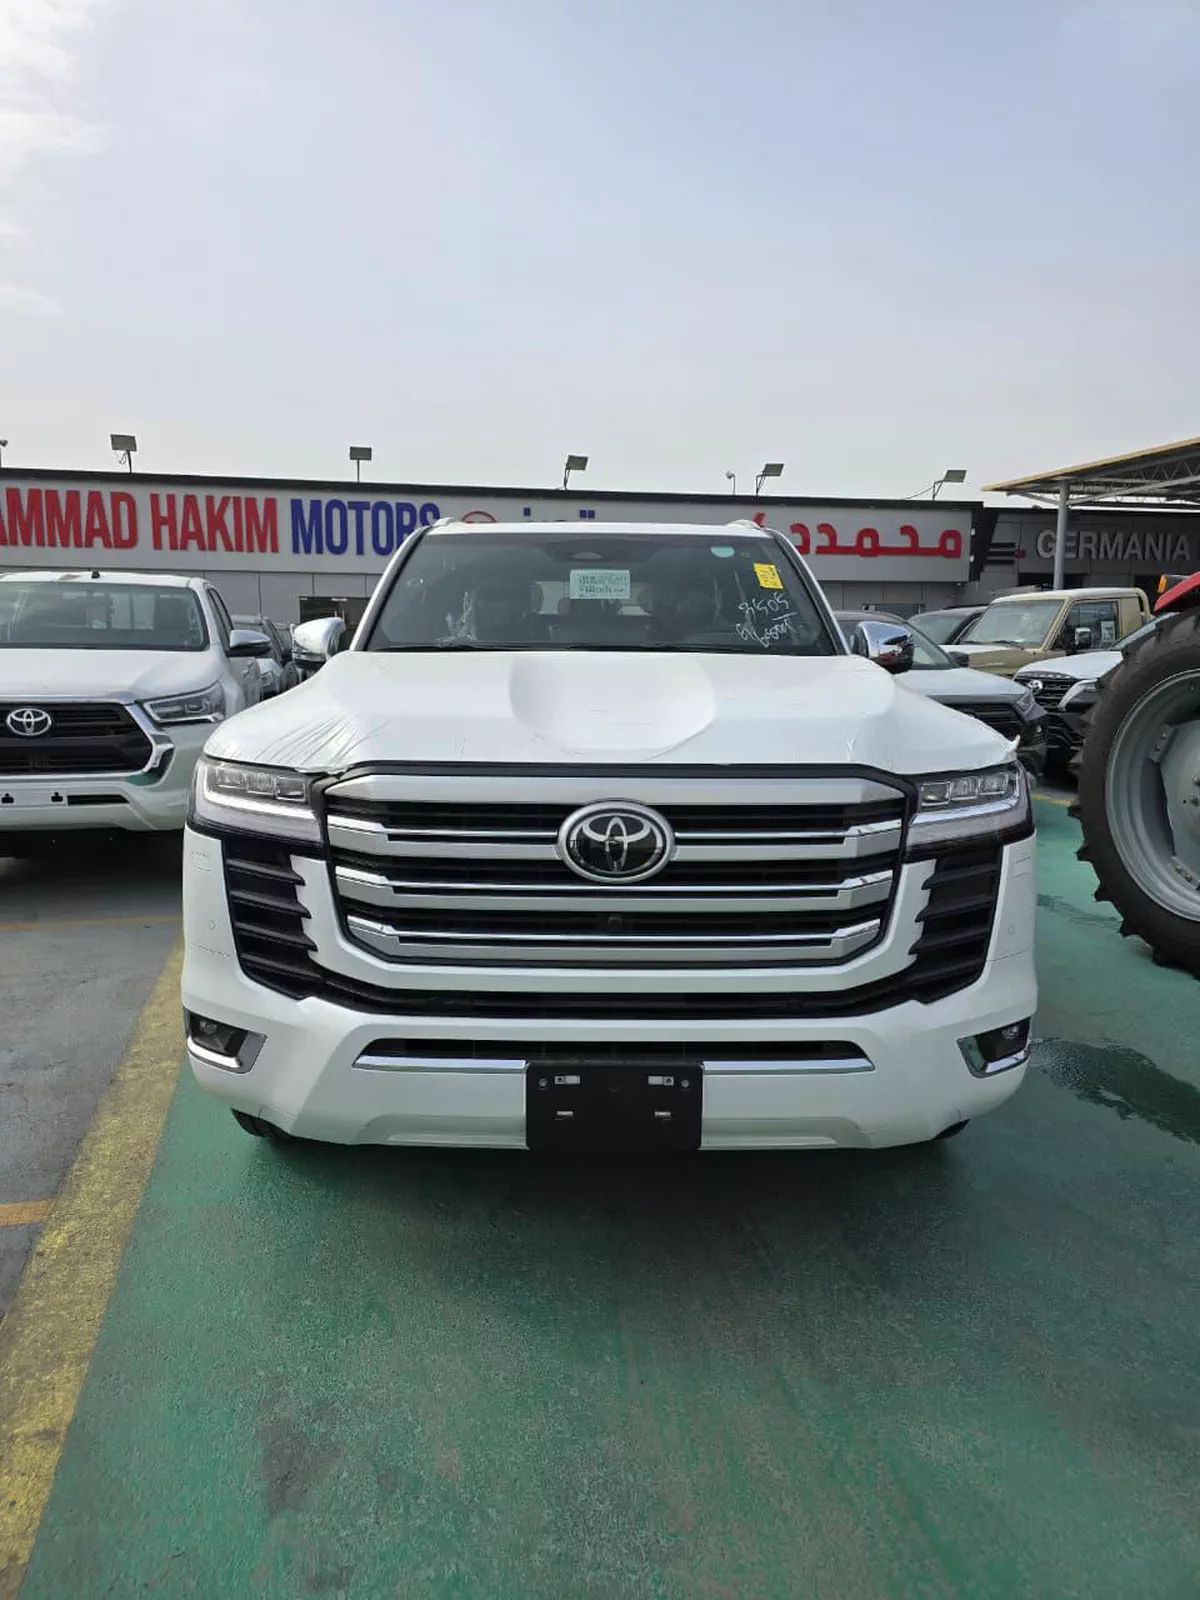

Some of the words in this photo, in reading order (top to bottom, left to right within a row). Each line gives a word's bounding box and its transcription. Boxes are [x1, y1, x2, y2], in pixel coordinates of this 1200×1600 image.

[0, 487, 139, 550] MMAD
[149, 493, 280, 554] HAKIM
[1037, 529, 1192, 561] GERMANIA
